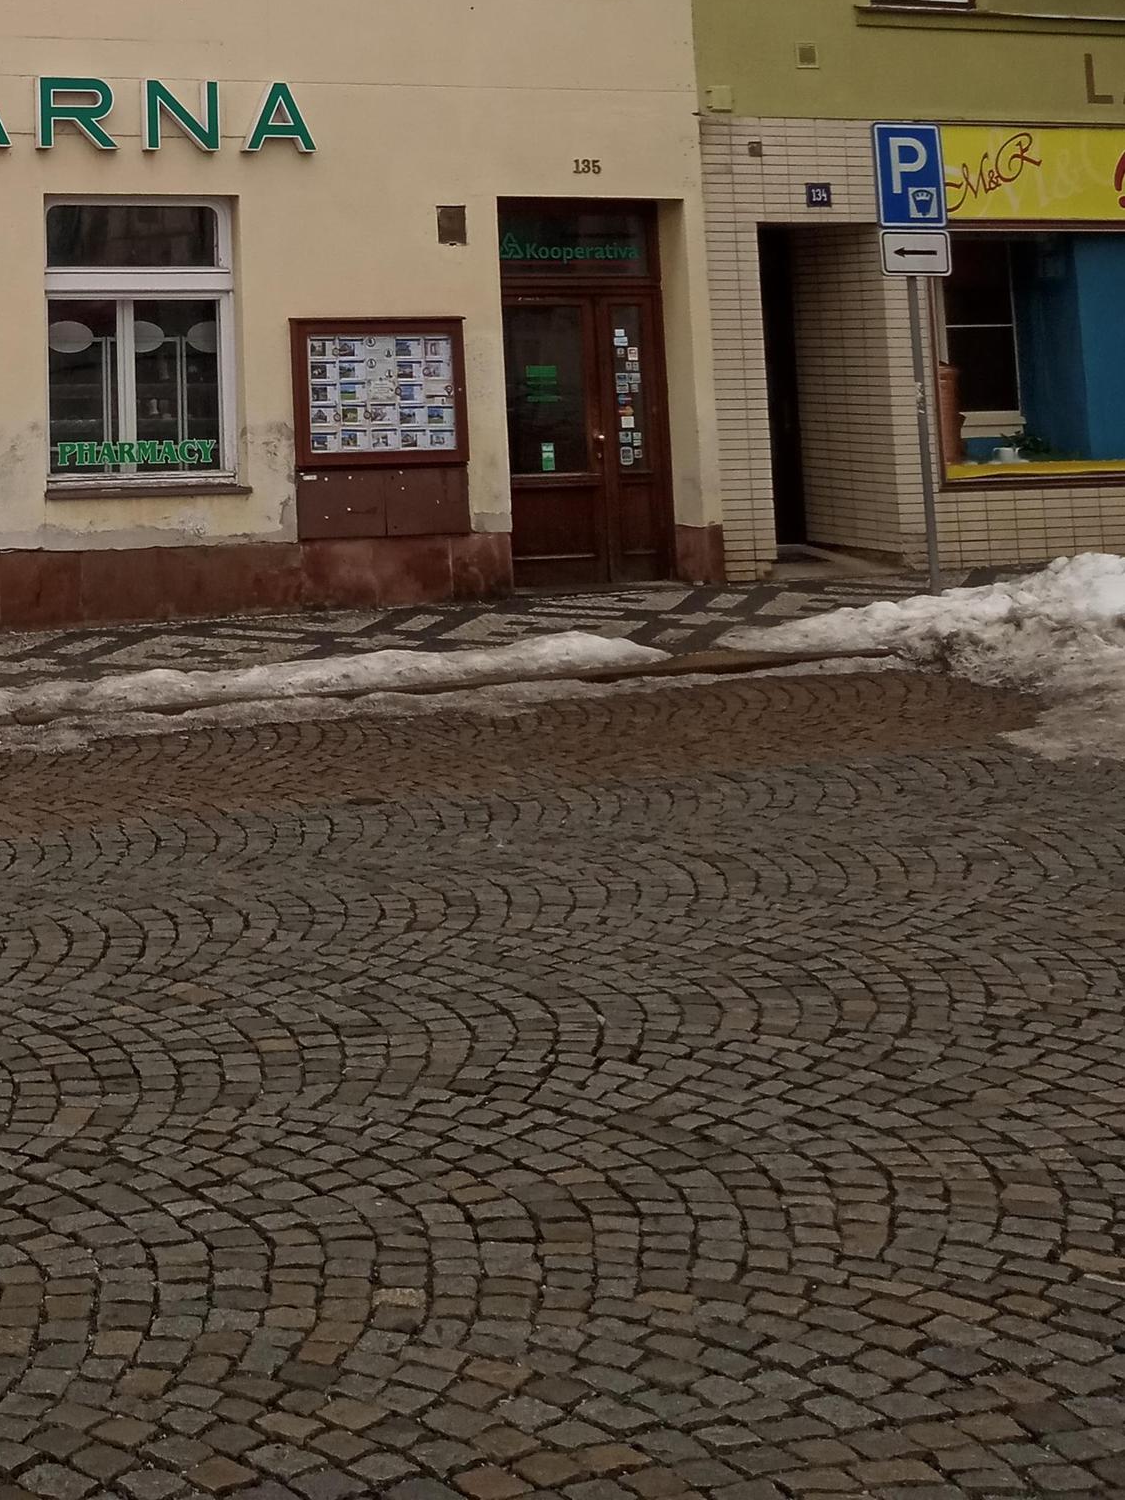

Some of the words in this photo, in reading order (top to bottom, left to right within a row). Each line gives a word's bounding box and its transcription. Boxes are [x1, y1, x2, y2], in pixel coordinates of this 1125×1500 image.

[573, 158, 602, 174] 135
[889, 136, 928, 194] P
[811, 188, 828, 202] 134
[525, 242, 641, 264] Kooperativa
[57, 439, 217, 467] PHARMACY
